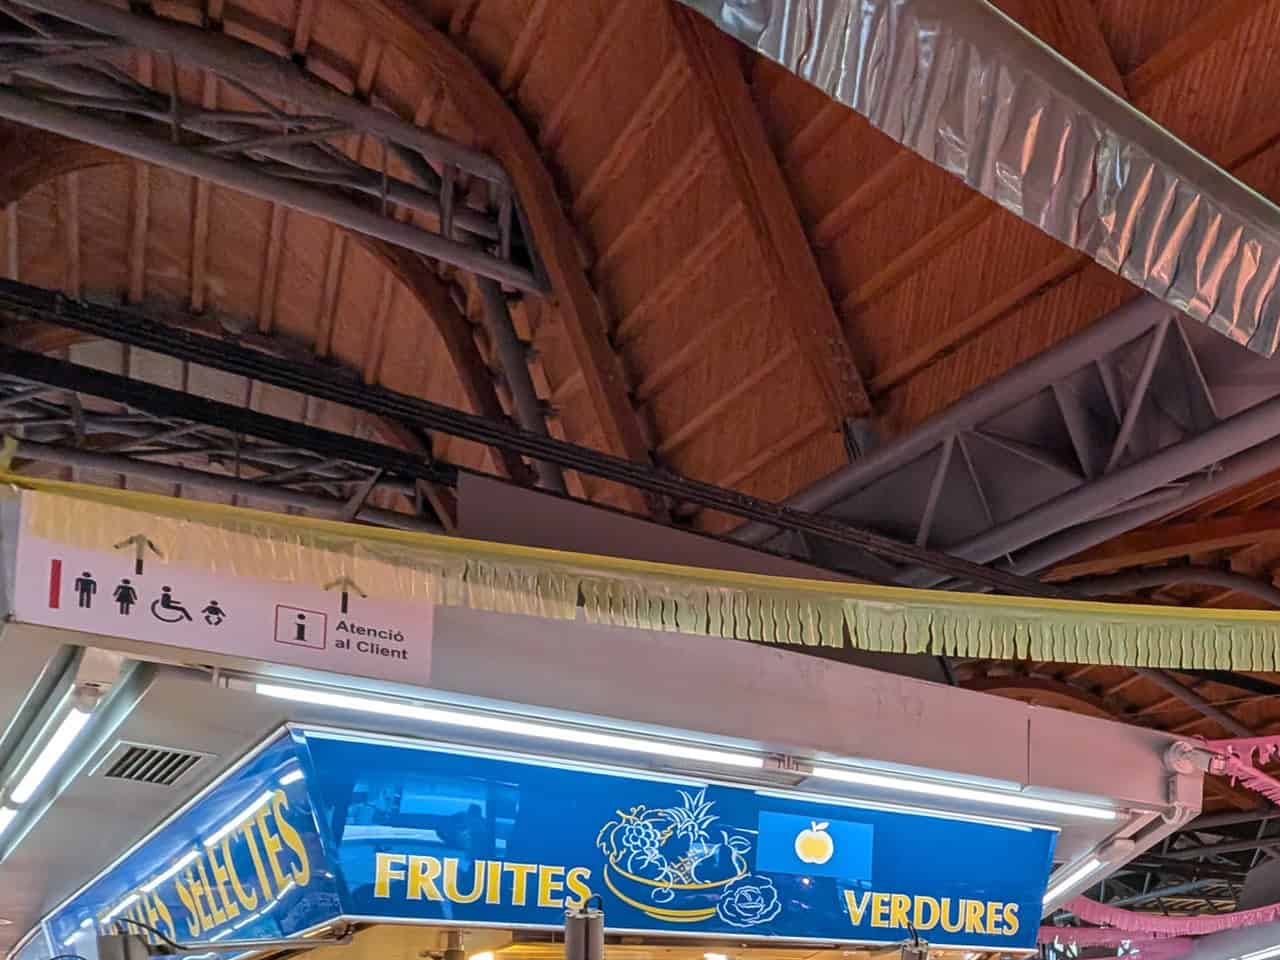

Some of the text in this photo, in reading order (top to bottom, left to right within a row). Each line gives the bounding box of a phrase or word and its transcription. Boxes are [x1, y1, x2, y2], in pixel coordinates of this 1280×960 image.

[335, 619, 405, 642] Atenció
[335, 638, 409, 660] al Client
[175, 788, 310, 937] SELECTES
[373, 852, 593, 910] FRUITES
[843, 889, 1020, 936] VERDURES
